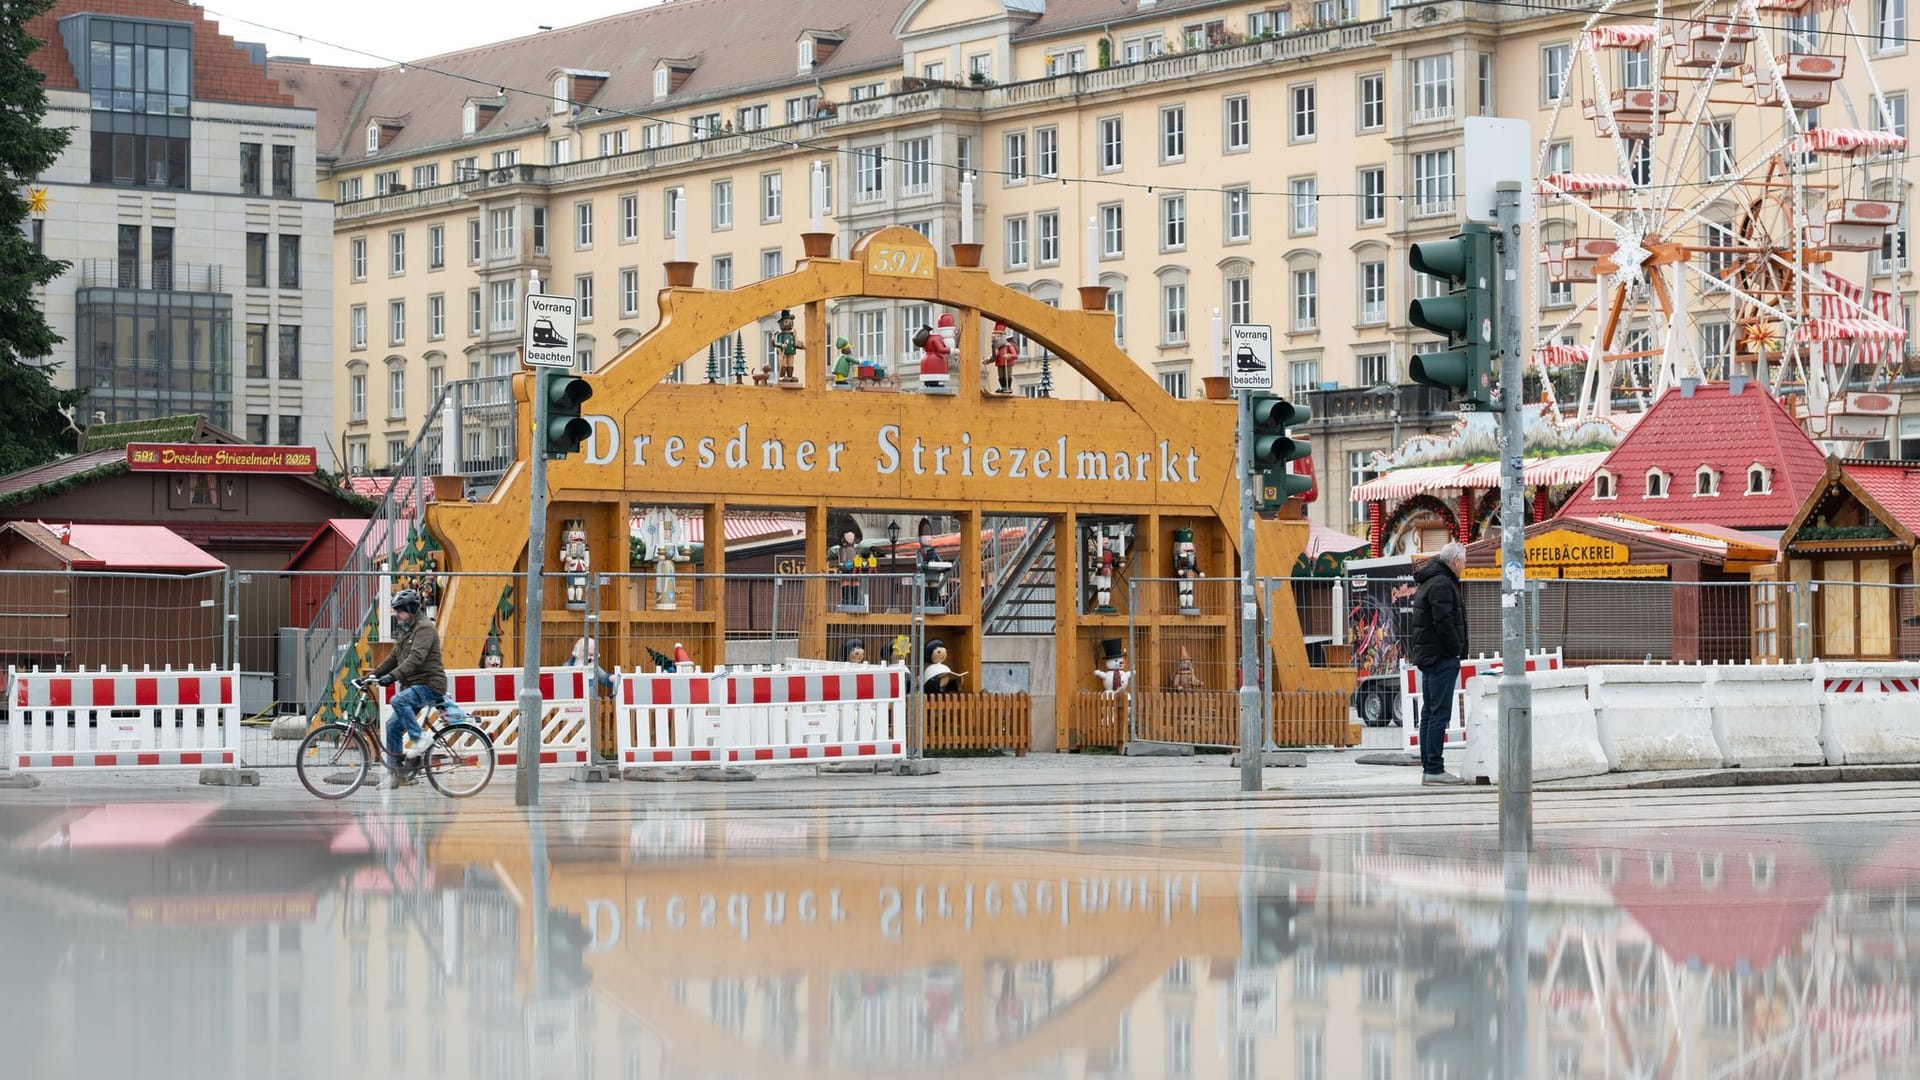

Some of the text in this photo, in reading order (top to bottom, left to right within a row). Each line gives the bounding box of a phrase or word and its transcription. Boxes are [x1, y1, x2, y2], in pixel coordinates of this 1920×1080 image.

[873, 248, 929, 275] 591.
[532, 300, 572, 315] Vorrang
[1234, 329, 1268, 341] Vorrang
[528, 350, 571, 362] beachten
[1233, 375, 1270, 385] beachten
[583, 413, 1201, 484] Dresdner Striezelmarkt
[162, 449, 213, 465] Dresdner
[215, 450, 283, 466] Striezelmarkt
[285, 453, 311, 465] 2025
[1523, 543, 1614, 561] AFFELBÄCKEREI
